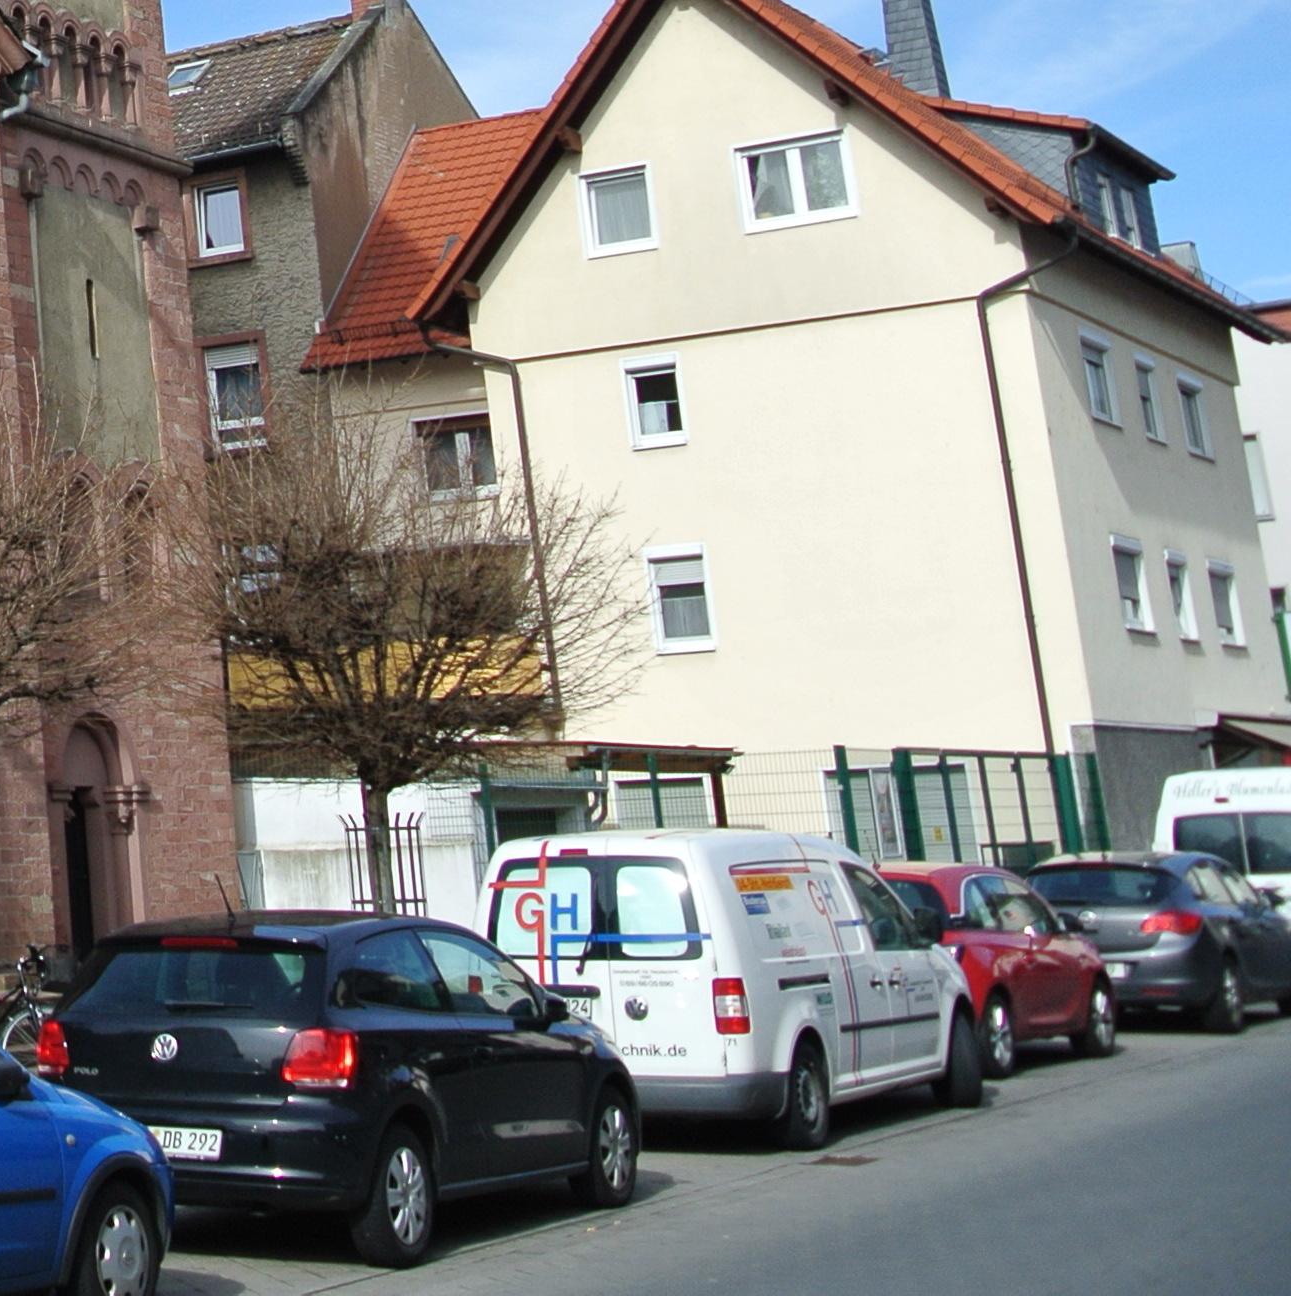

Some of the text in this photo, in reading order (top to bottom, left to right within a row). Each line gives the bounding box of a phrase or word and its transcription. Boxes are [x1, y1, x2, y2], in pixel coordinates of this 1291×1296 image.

[621, 1043, 688, 1058] chnik.de
[162, 1130, 218, 1152] DB 292
